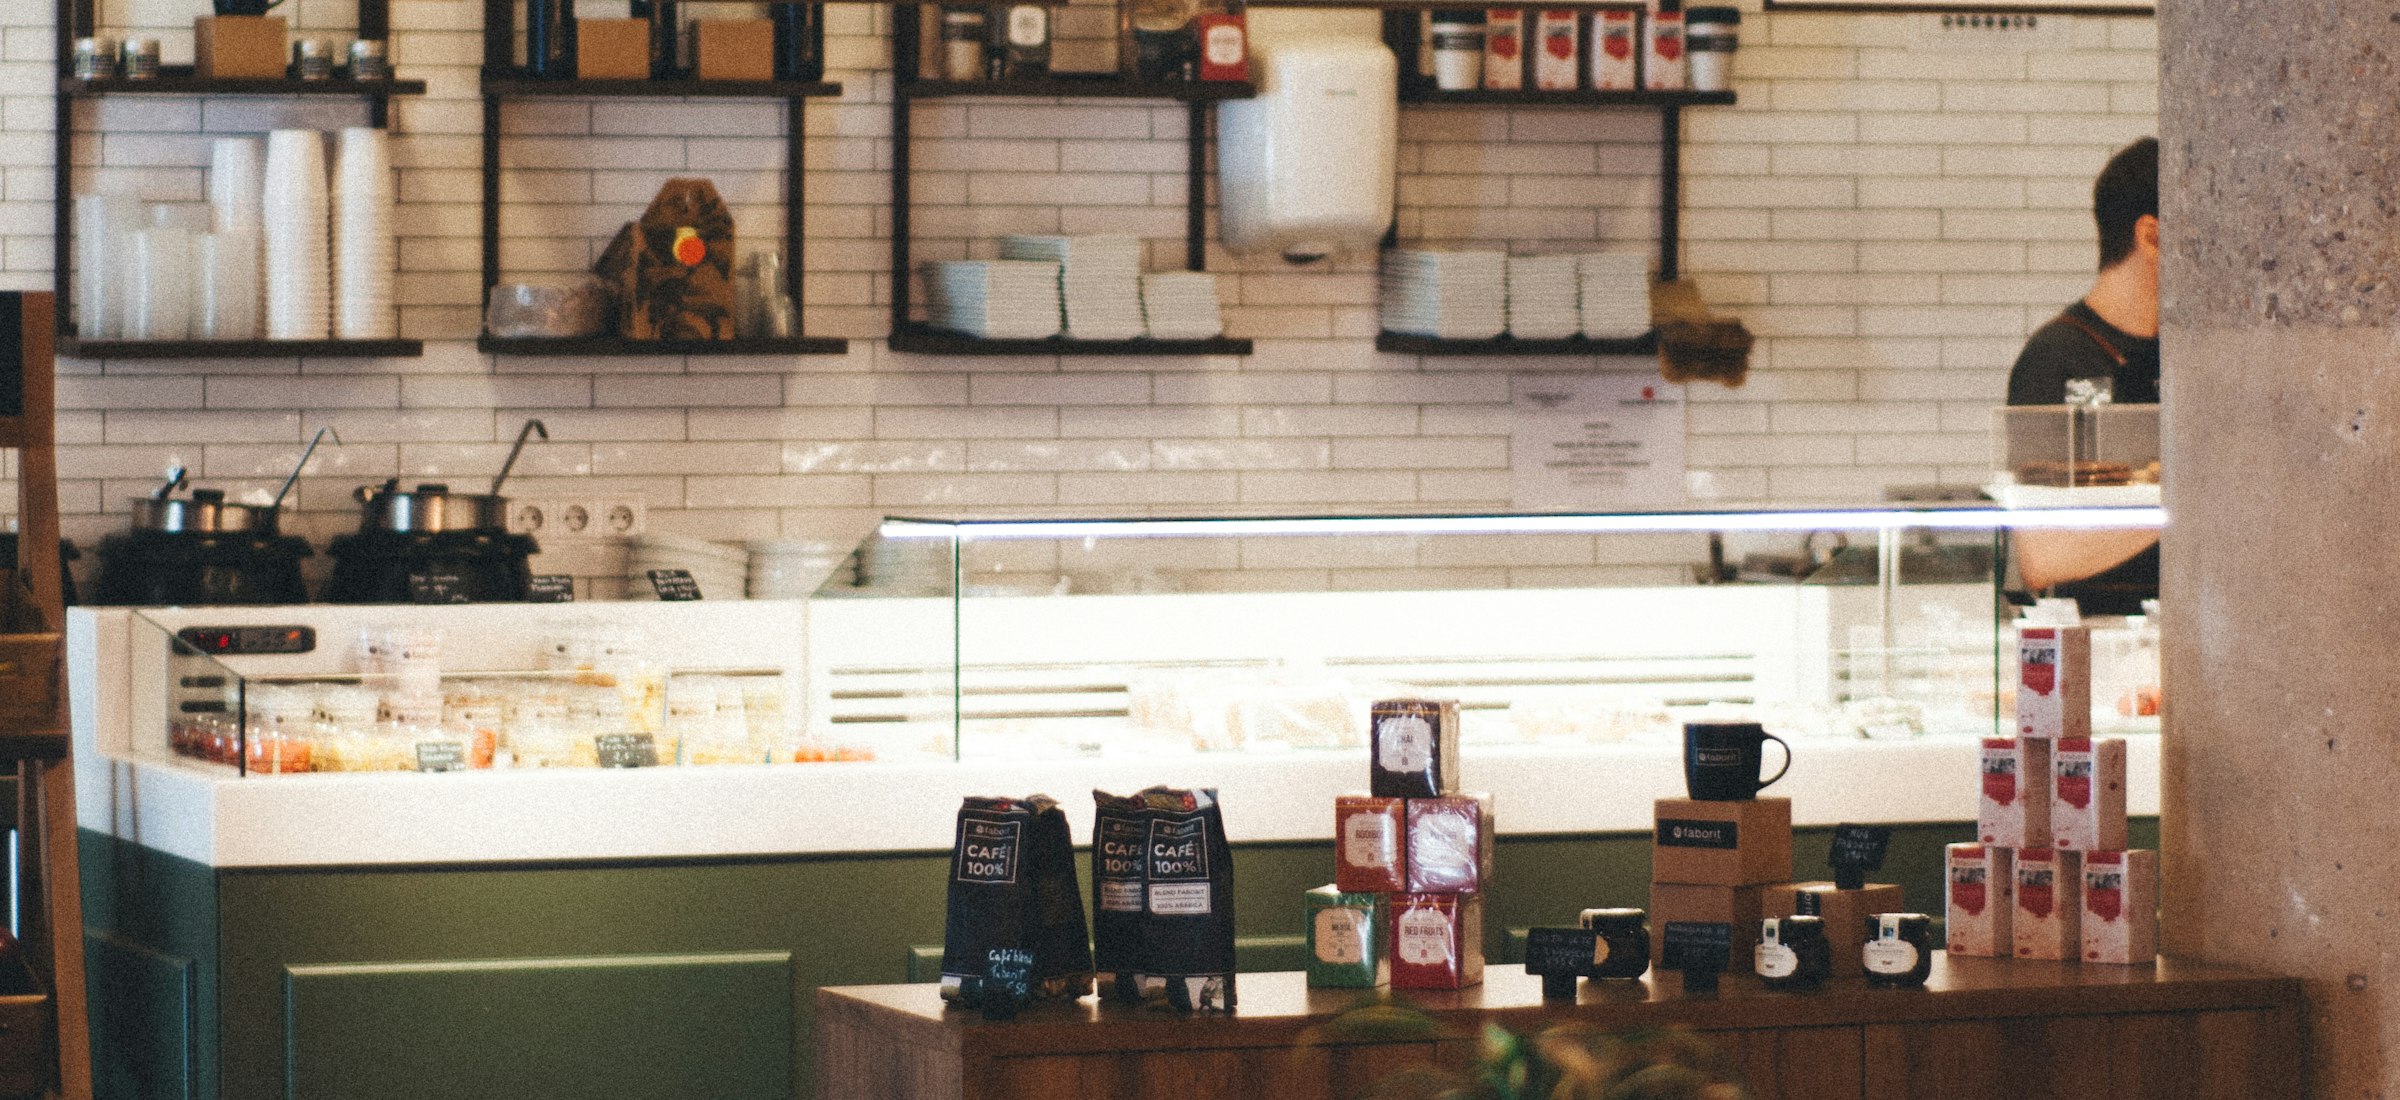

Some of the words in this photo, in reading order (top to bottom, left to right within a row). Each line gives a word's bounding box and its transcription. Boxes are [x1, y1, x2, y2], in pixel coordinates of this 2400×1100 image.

[1683, 828, 1721, 839] faborit
[967, 843, 1007, 860] CAFÉ
[1154, 841, 1195, 858] CAFÉ
[967, 861, 1004, 876] 100%
[1155, 861, 1197, 874] 100%
[1404, 925, 1418, 936] RED
[1420, 925, 1444, 937] FRUITS
